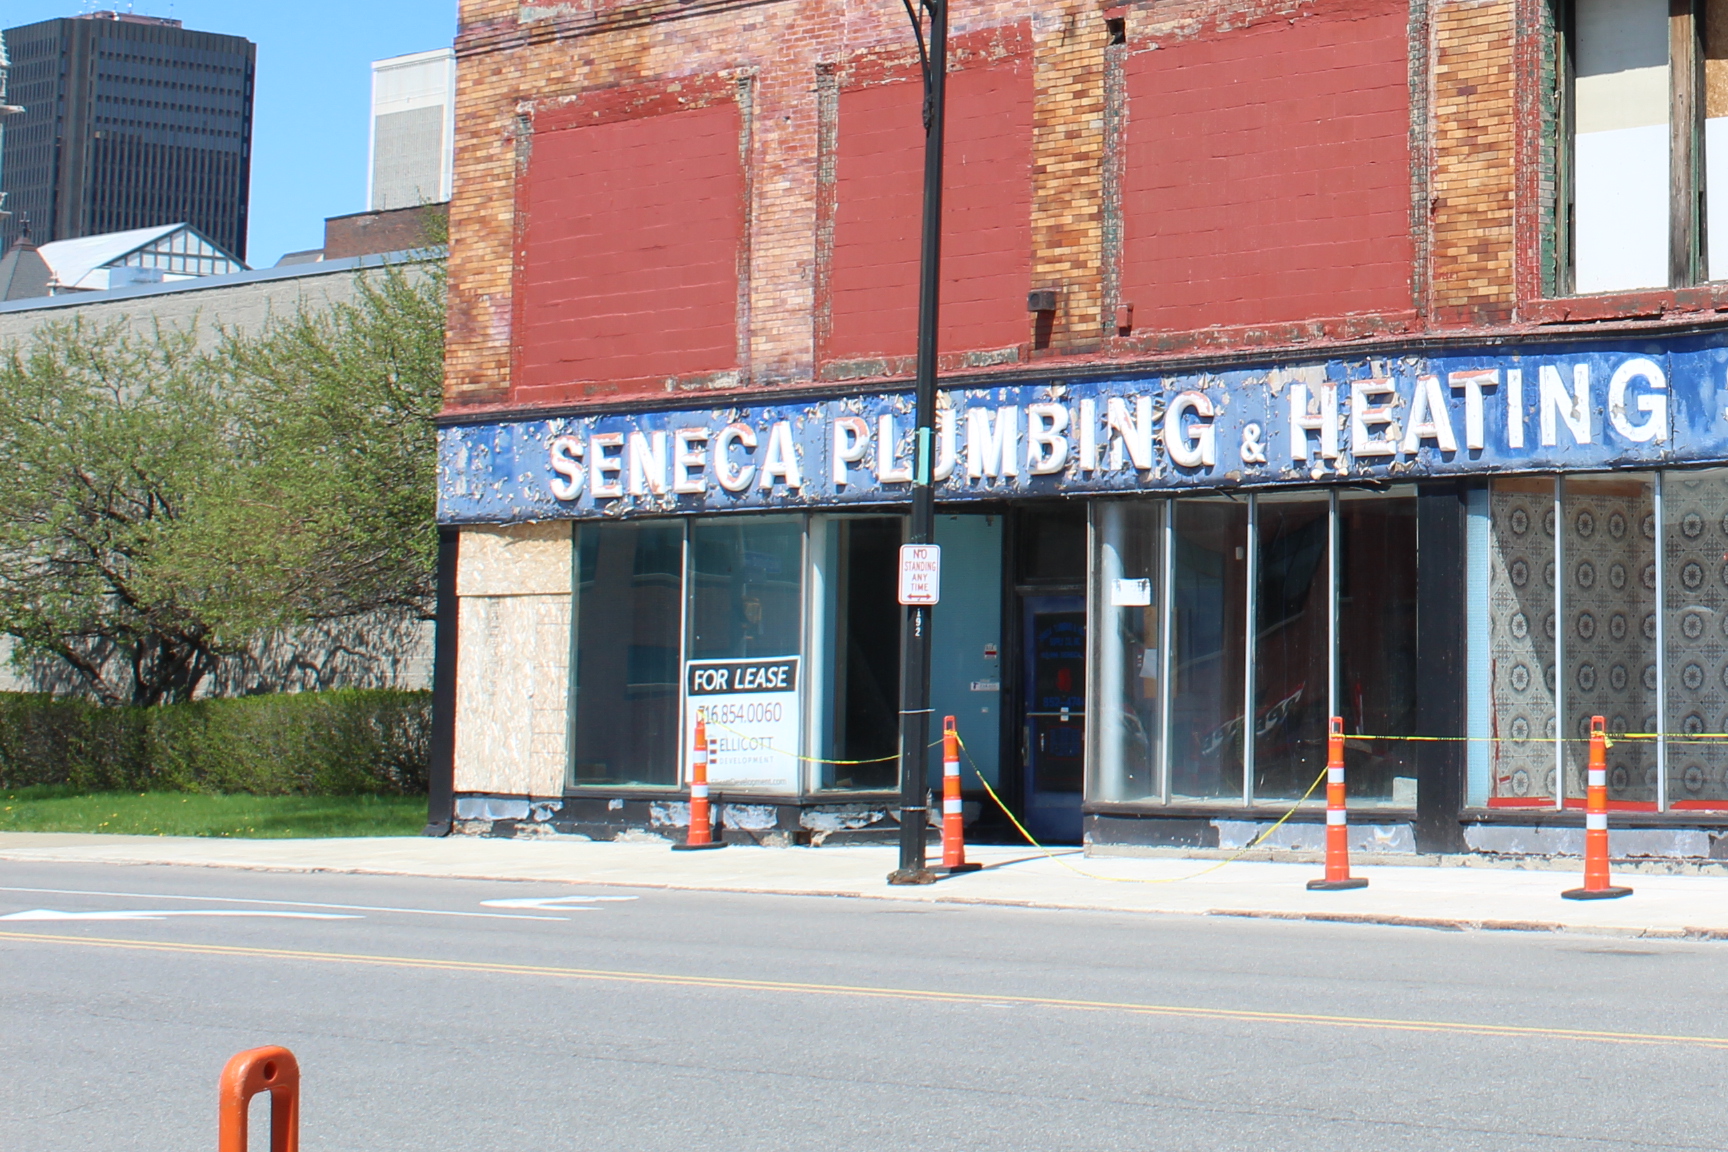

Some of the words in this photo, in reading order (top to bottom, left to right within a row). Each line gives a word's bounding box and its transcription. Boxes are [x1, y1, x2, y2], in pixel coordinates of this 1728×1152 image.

[548, 420, 802, 501] SENECA
[832, 390, 1216, 486] PLUMBING
[1240, 421, 1267, 464] &
[1290, 358, 1668, 461] HEATING
[913, 549, 928, 560] NO
[904, 561, 937, 571] STANDING
[912, 573, 928, 581] ANY
[910, 583, 929, 591] TIME
[694, 669, 729, 691] FOR
[734, 666, 789, 689] LEASE
[719, 736, 775, 752] ELLICOTT
[719, 755, 775, 765] DEVELOPMENT
